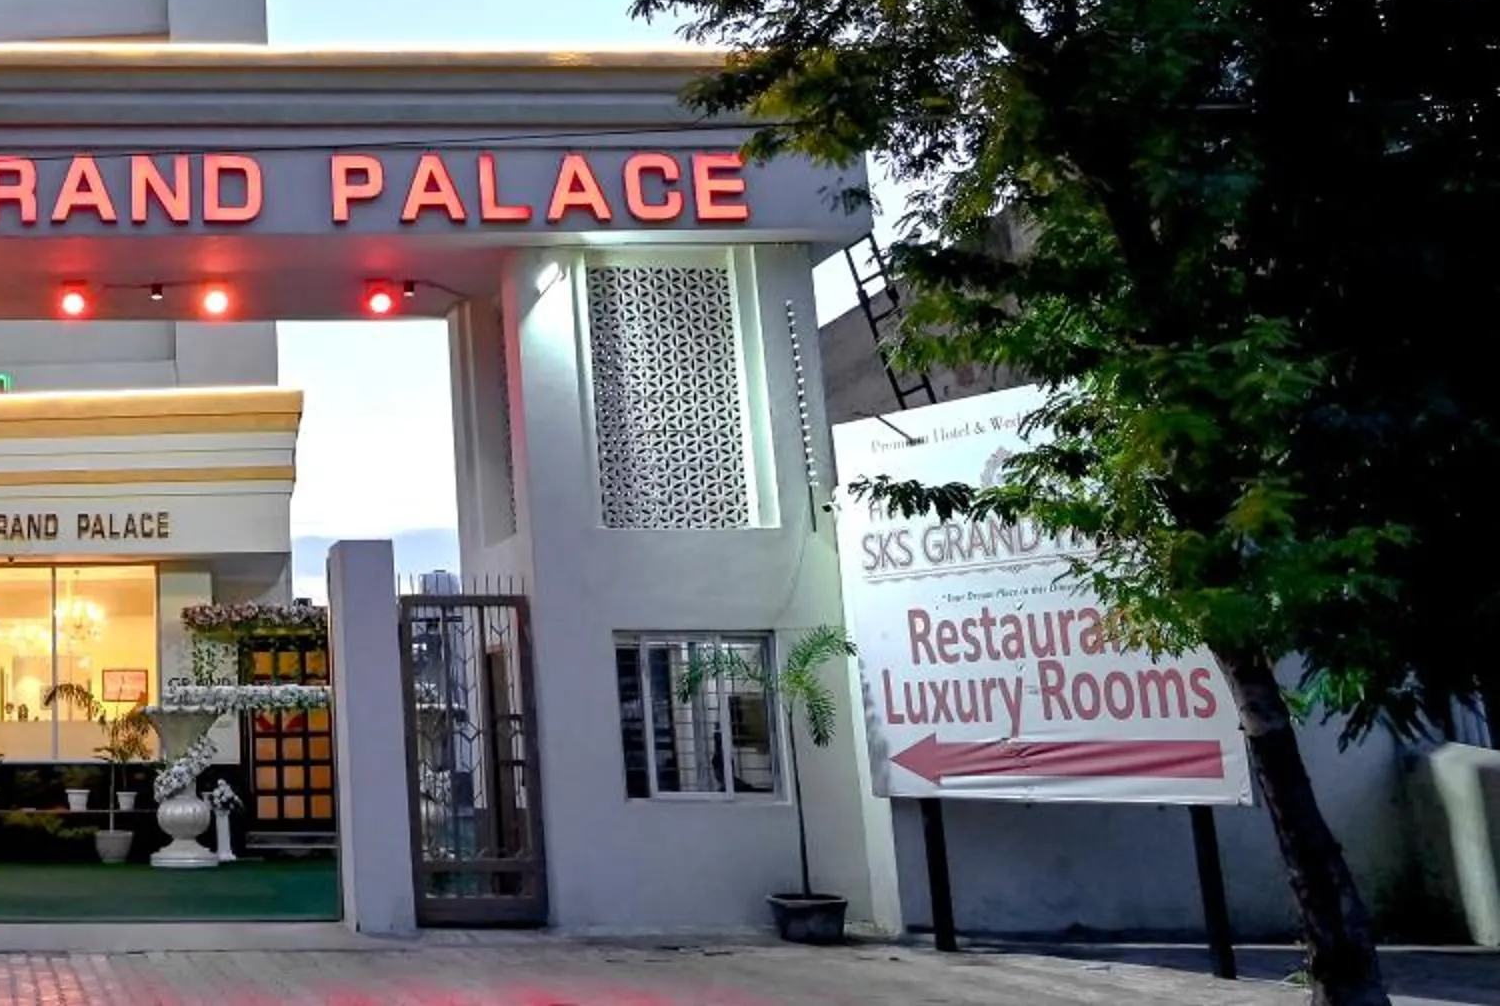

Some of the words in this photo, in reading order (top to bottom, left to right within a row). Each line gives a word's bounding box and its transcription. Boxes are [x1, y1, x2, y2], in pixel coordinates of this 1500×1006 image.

[330, 152, 750, 222] PALACE
[77, 511, 171, 540] PALACE
[861, 528, 914, 571] SKS
[922, 513, 1042, 564] GRAND
[907, 605, 1146, 665] Restaura
[881, 667, 1024, 738] Luxury
[1037, 658, 1218, 722] Rooms
